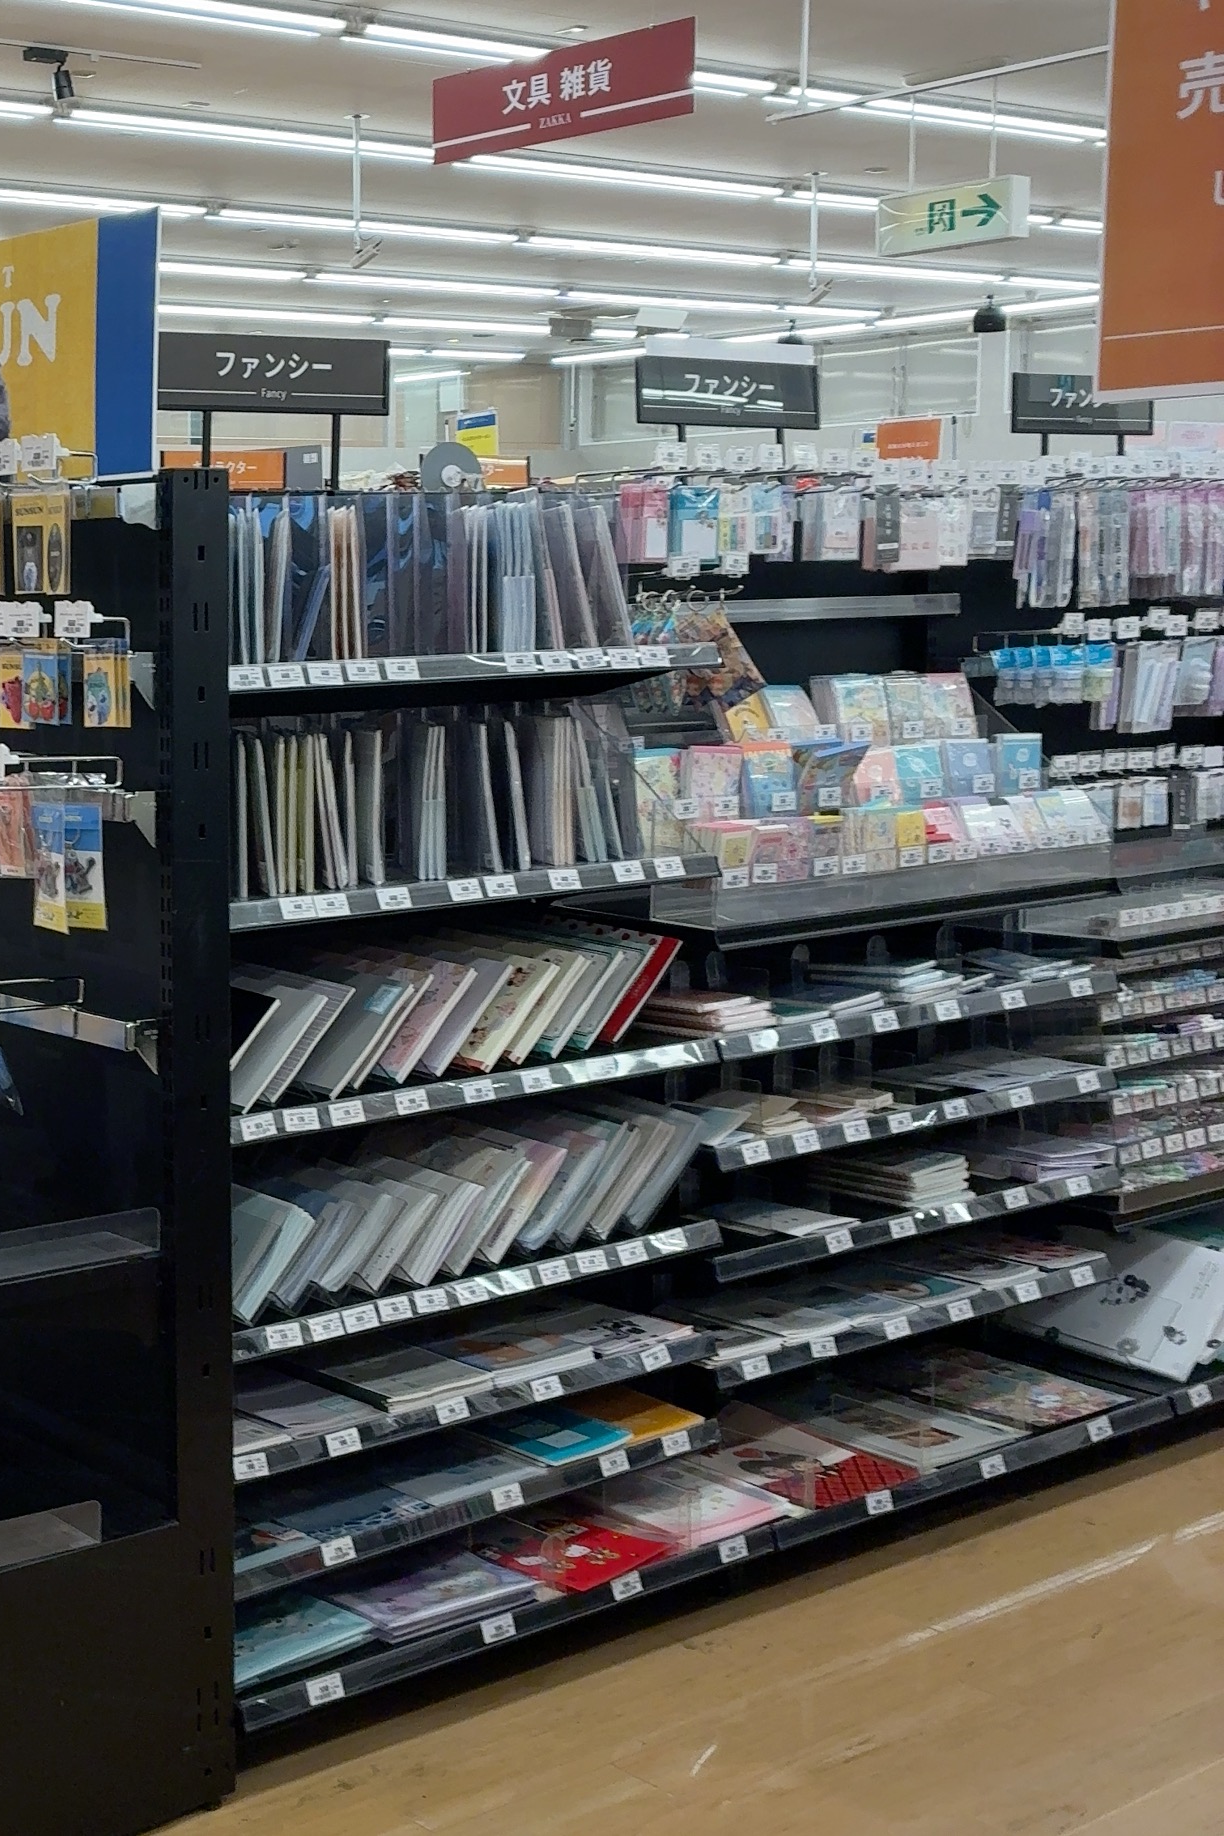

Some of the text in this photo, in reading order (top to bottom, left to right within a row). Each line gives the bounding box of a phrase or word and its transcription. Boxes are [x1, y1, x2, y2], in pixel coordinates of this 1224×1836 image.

[501, 58, 613, 114] 文具 雑貨
[539, 113, 572, 129] ZAKKA
[215, 351, 333, 380] ファンシー
[260, 388, 288, 401] Fancy
[684, 373, 775, 397] ファンシー
